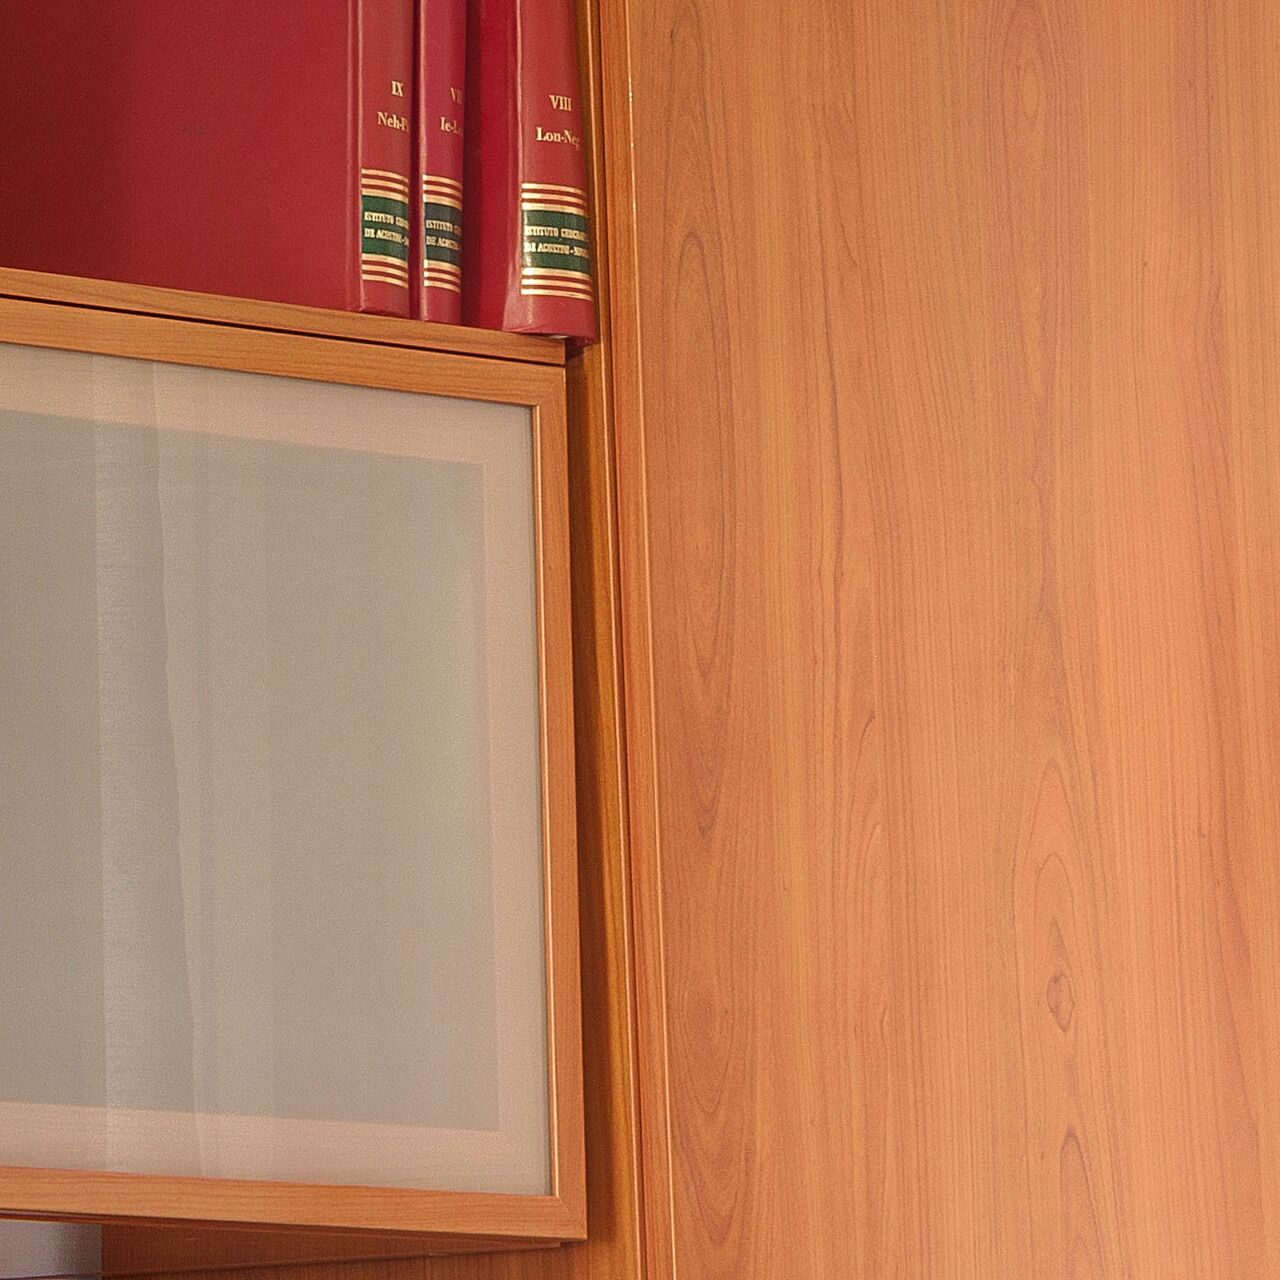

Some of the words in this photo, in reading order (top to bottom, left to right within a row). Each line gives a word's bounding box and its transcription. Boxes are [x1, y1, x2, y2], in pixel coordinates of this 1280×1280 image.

[391, 80, 403, 97] IX
[549, 94, 572, 111] VIII
[523, 225, 559, 237] ISTITUTO
